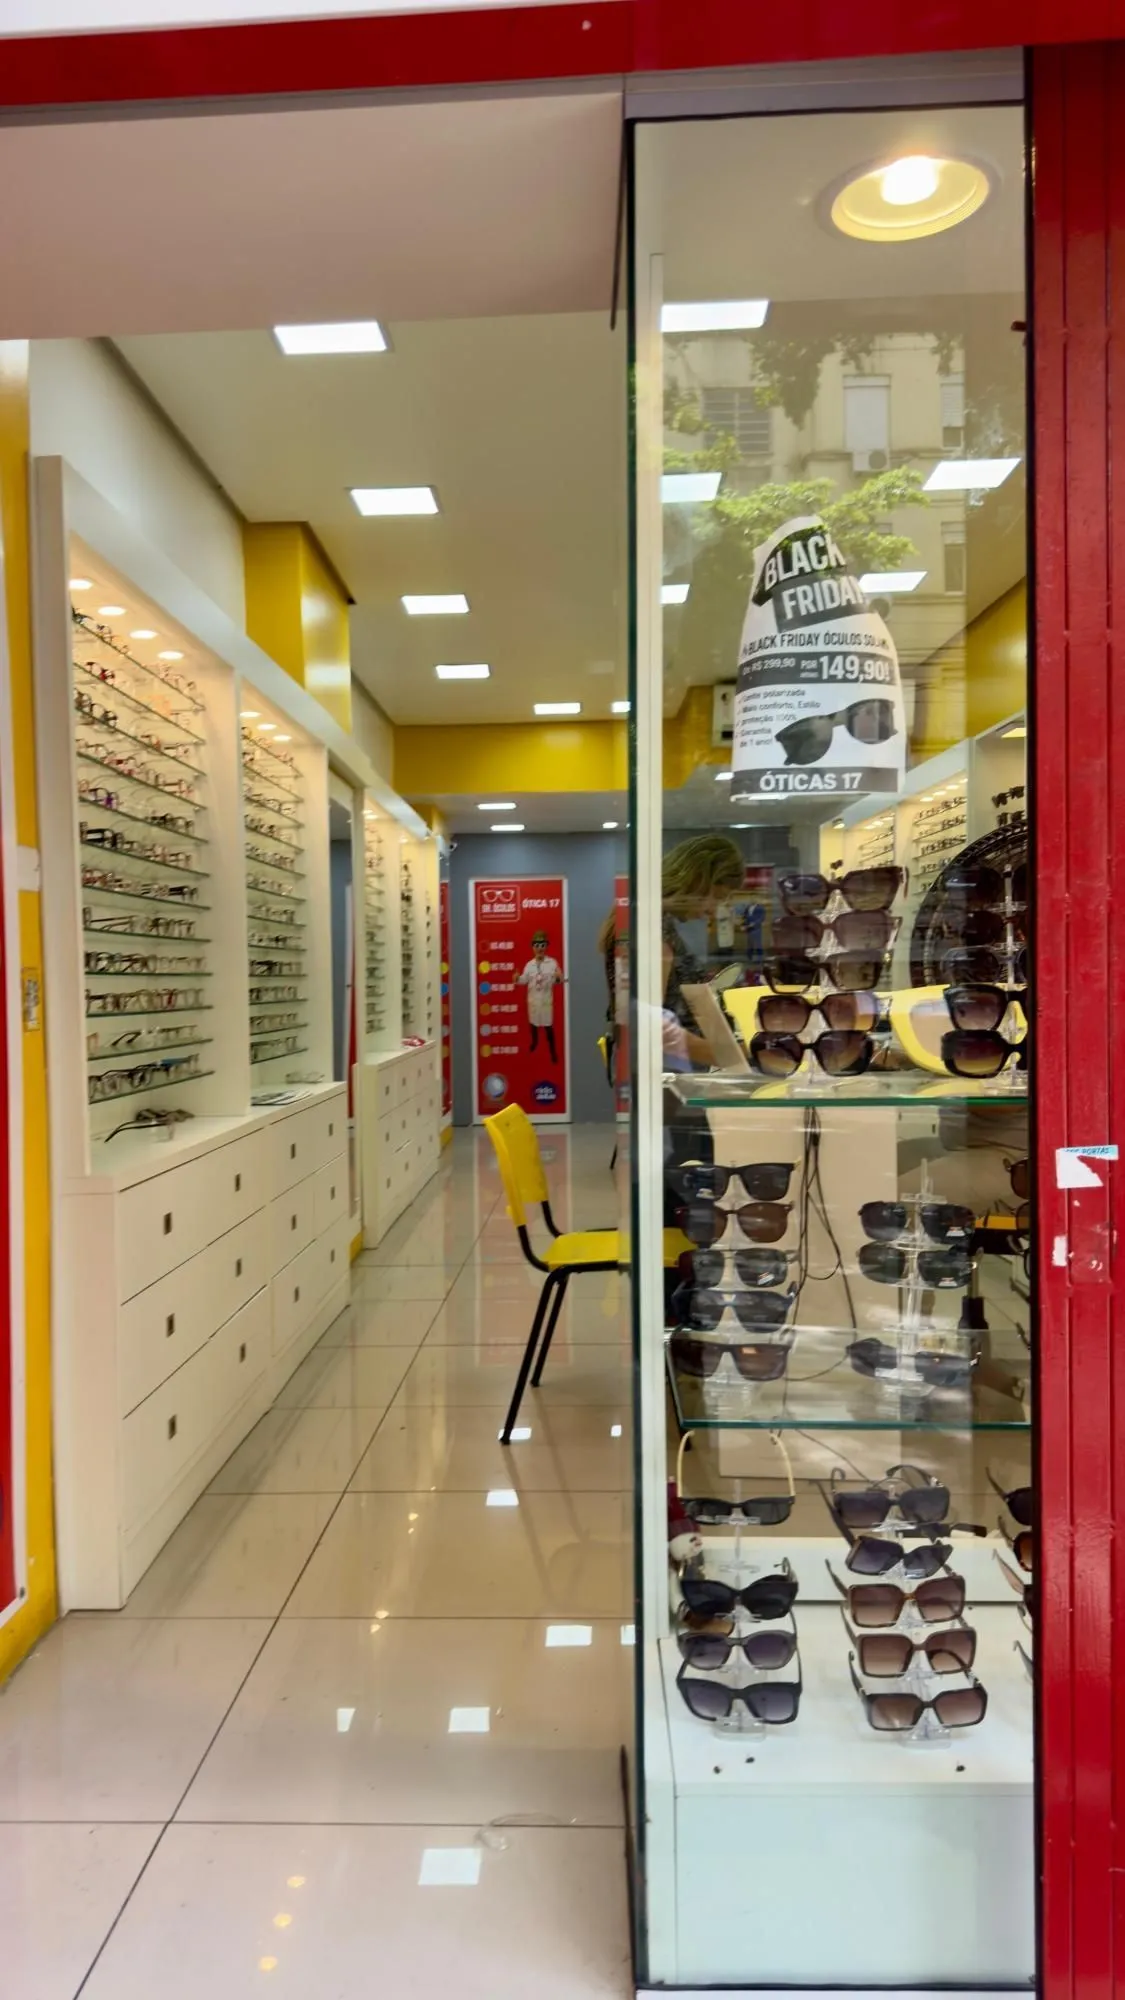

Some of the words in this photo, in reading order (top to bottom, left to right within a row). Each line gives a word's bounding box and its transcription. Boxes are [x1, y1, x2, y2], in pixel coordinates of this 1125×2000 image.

[764, 532, 846, 591] BLACK
[750, 635, 777, 653] BLACK
[780, 632, 820, 647] FRIDAY
[824, 630, 861, 646] ÓCULOS
[763, 657, 796, 670] 299,90
[819, 655, 890, 683] 149,90!
[759, 771, 837, 790] ÓTICAS
[841, 773, 862, 789] 17
[549, 899, 560, 908] 17
